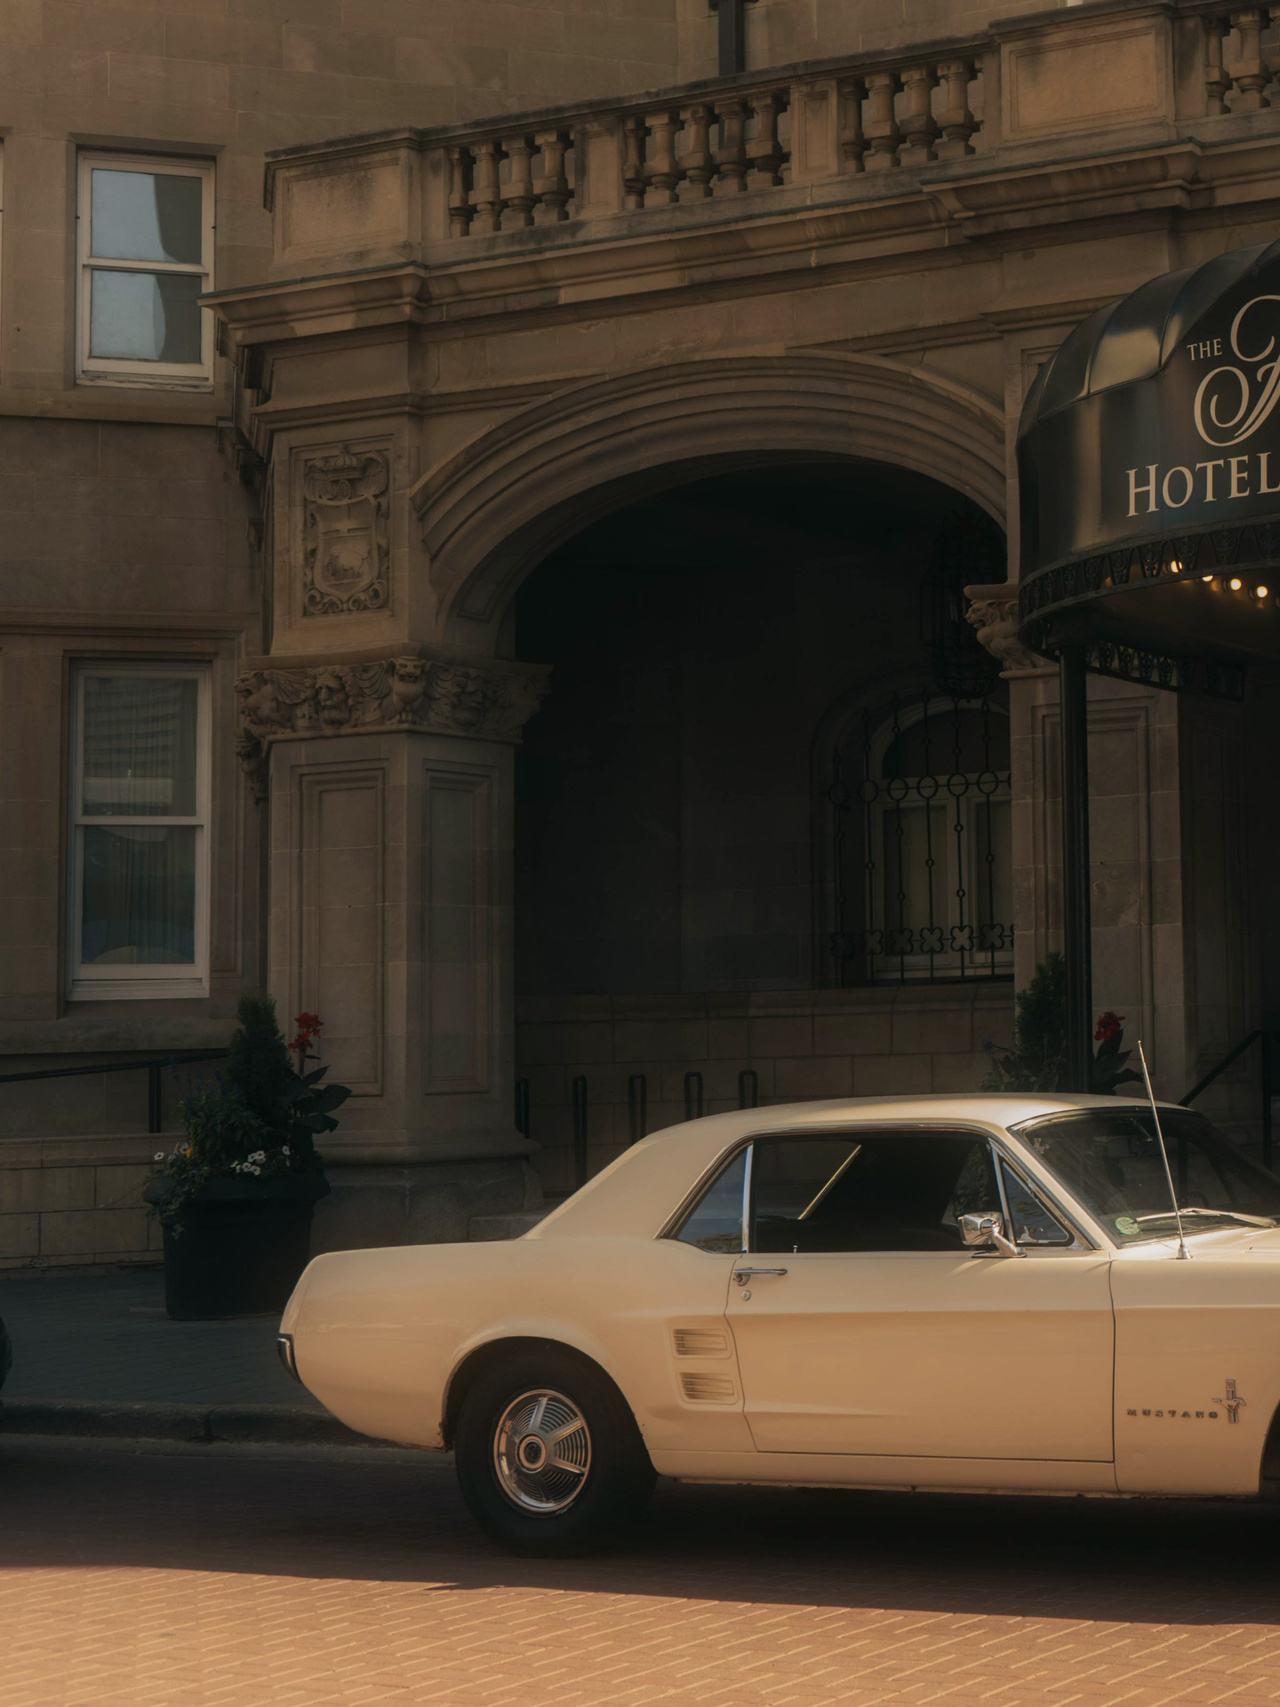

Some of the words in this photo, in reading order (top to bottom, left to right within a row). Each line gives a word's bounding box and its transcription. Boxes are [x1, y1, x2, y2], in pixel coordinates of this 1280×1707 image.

[1187, 338, 1223, 362] THE
[1126, 450, 1280, 518] HOTEL
[1126, 1408, 1219, 1419] MUSTANG
